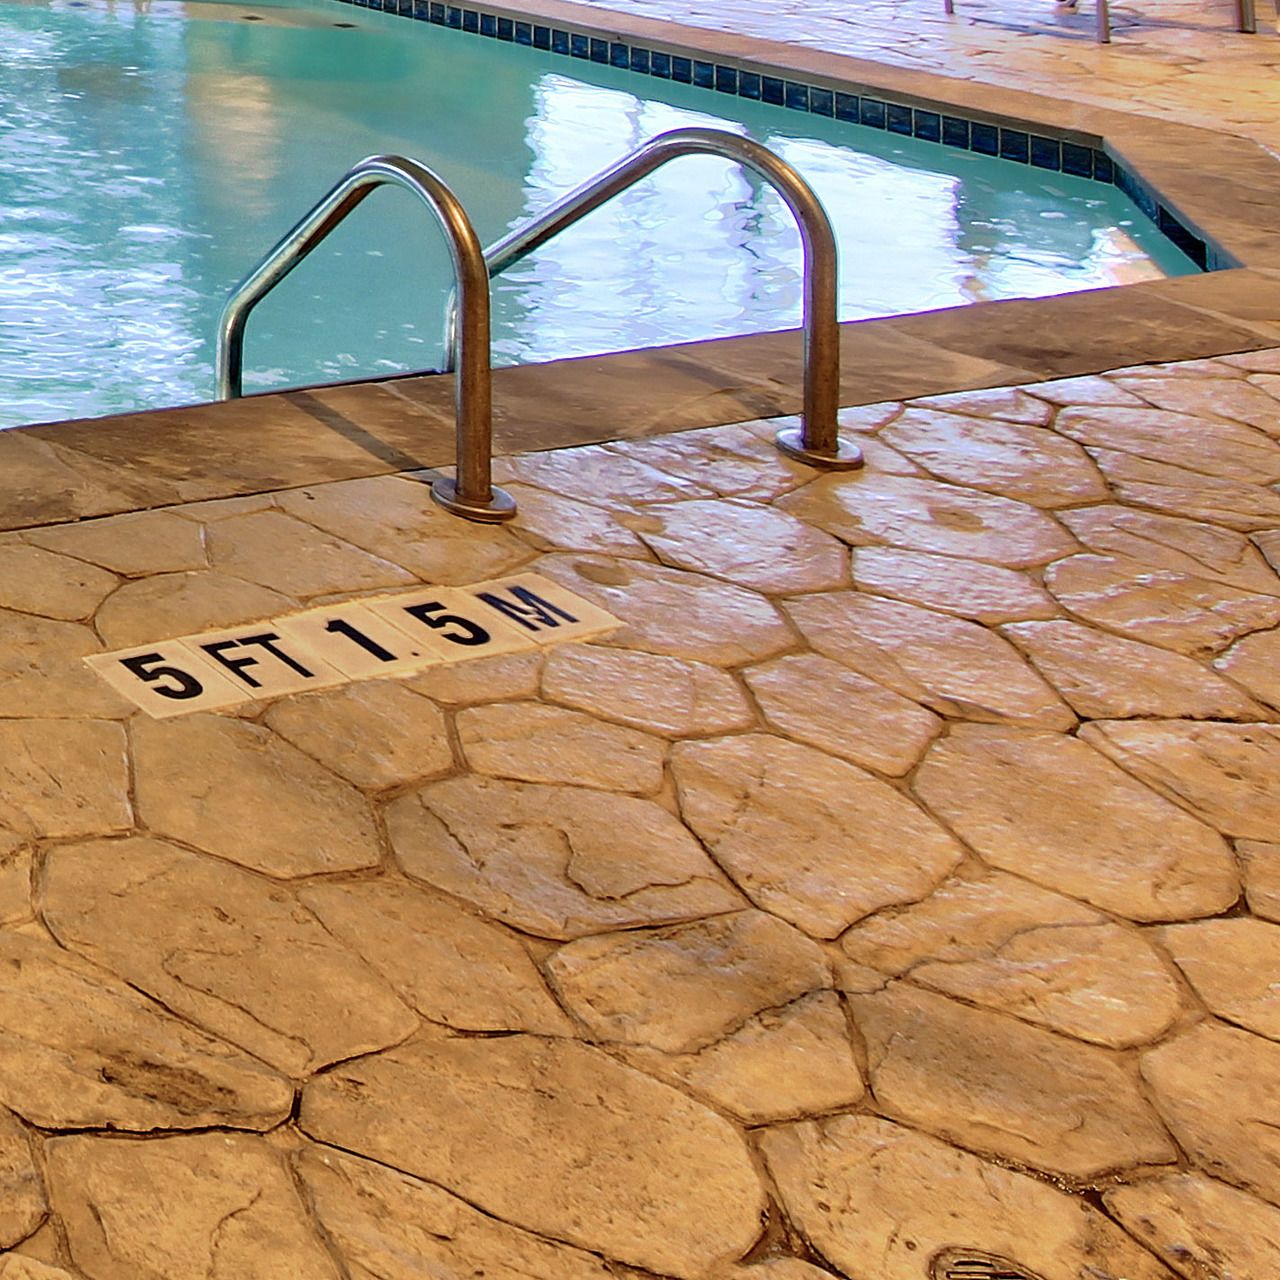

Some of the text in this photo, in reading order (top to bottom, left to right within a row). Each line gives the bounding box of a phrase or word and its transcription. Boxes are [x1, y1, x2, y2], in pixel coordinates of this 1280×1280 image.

[118, 652, 203, 701] 5
[200, 632, 315, 688] FT
[475, 585, 581, 632] M
